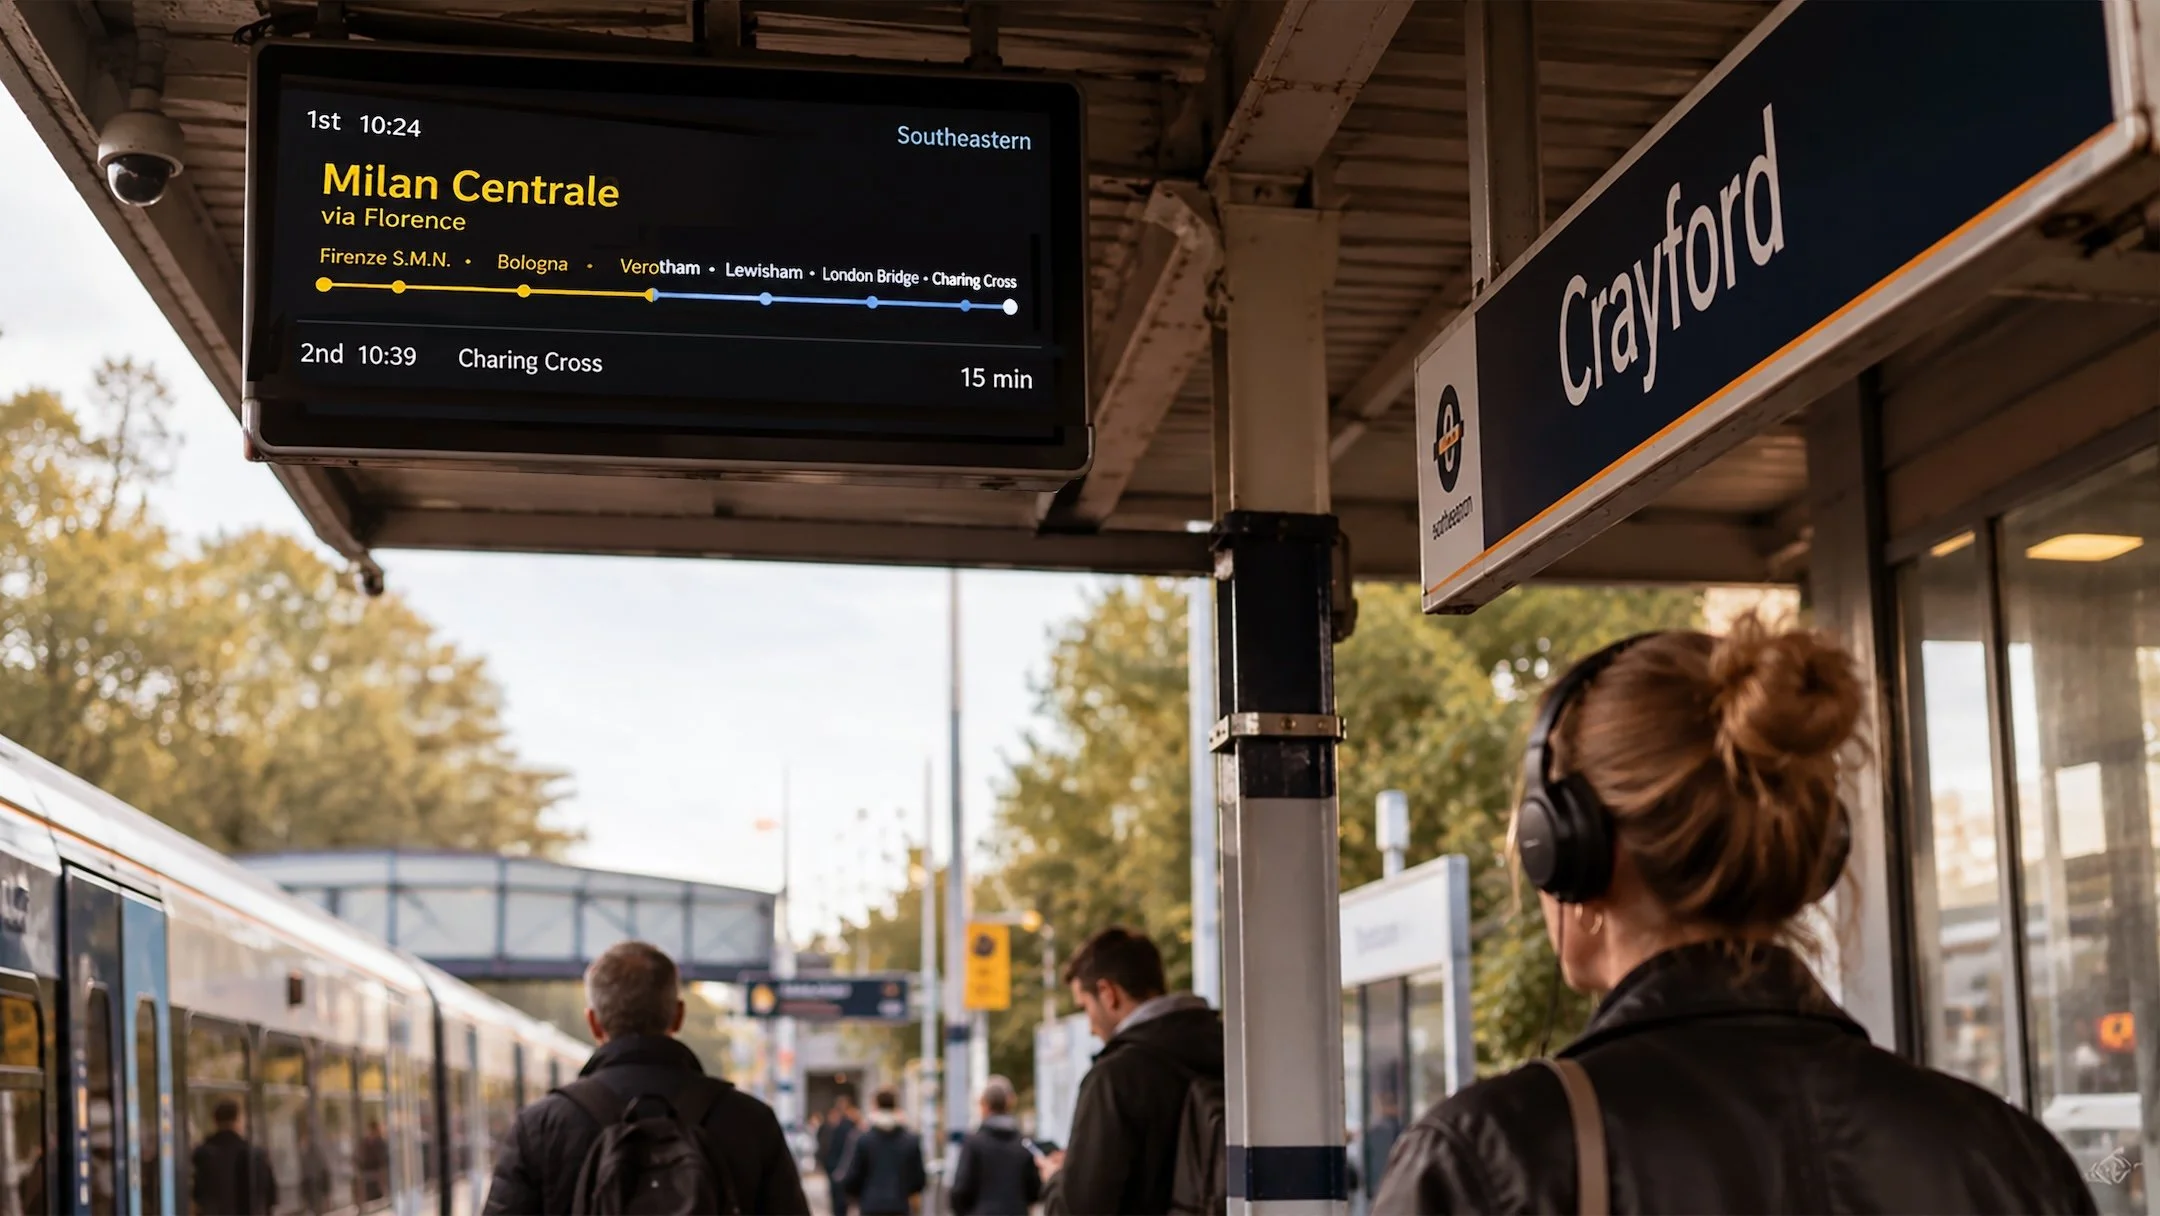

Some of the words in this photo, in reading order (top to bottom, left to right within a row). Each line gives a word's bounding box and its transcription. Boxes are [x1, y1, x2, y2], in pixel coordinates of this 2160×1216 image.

[308, 110, 341, 131] 1st
[360, 115, 421, 137] 10:24
[898, 125, 1031, 150] Southeastern
[323, 163, 438, 200] Milan
[453, 169, 619, 207] Centrale
[321, 206, 355, 226] via
[364, 208, 466, 231] Florence
[320, 247, 387, 265] Firenze
[392, 250, 450, 268] S.M.N.
[498, 253, 568, 275] Bologna
[725, 262, 803, 280] Lewisham
[822, 266, 873, 283] London
[877, 268, 919, 287] Bridge
[932, 271, 981, 290] Charing
[983, 273, 1018, 289] Cross
[1560, 103, 1784, 406] Crayford
[300, 343, 343, 364] 2nd
[359, 345, 417, 366] 10:39
[458, 348, 538, 375] Charing
[545, 352, 603, 373] Cross
[960, 366, 985, 388] 15
[993, 367, 1033, 390] min
